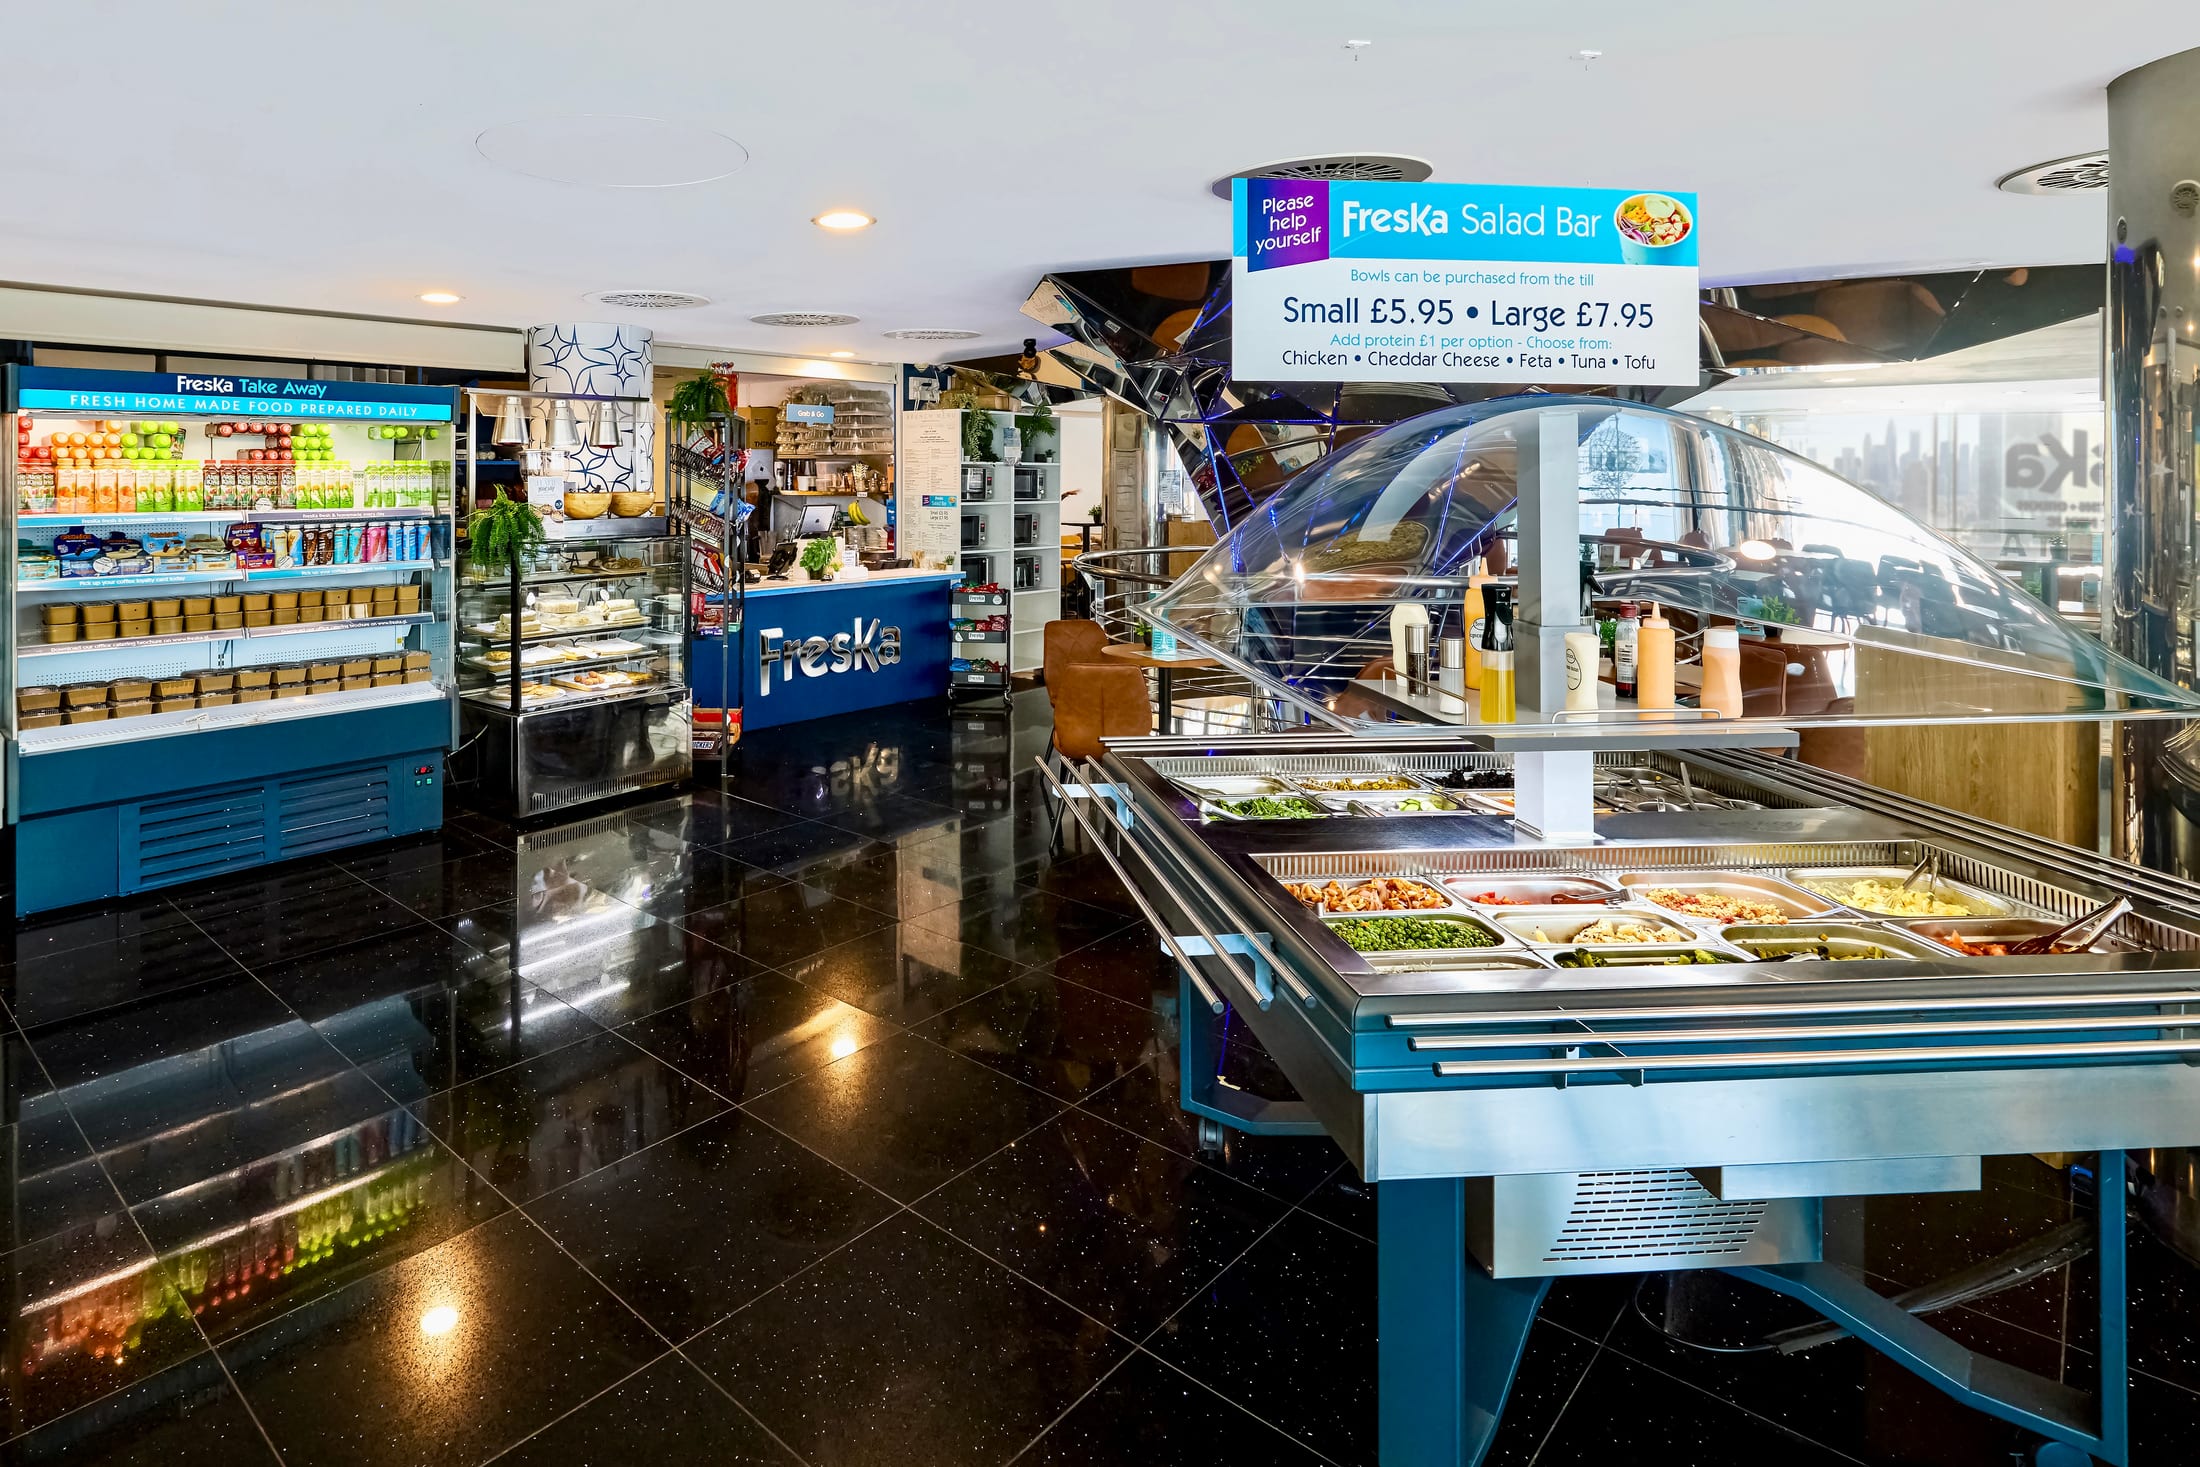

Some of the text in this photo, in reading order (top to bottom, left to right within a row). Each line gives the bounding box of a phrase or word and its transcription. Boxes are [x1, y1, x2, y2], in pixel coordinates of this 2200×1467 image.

[1263, 194, 1314, 214] Please
[1269, 212, 1307, 232] help
[1343, 201, 1602, 238] FresKa Salad Bar
[1255, 226, 1321, 255] yourself
[1351, 269, 1594, 286] Bowls can be purchased from the till
[1283, 296, 1654, 333] Small £5.95 Large £7.95
[1330, 333, 1361, 347] Add
[1365, 334, 1415, 348] protein
[1419, 334, 1435, 347] £1
[1441, 337, 1465, 350] per
[1468, 336, 1513, 350] option
[1526, 336, 1575, 350] Choose
[1579, 336, 1613, 350] from:
[1282, 350, 1656, 370] Chicken Cheddar Cheese Feta Tuna Tofu
[239, 378, 278, 394] Take
[282, 381, 327, 399] Away
[70, 394, 418, 417] FRESH HOME MADE FOOD PREPARED DAILY
[816, 410, 825, 418] Go
[760, 616, 901, 697] FresKa
